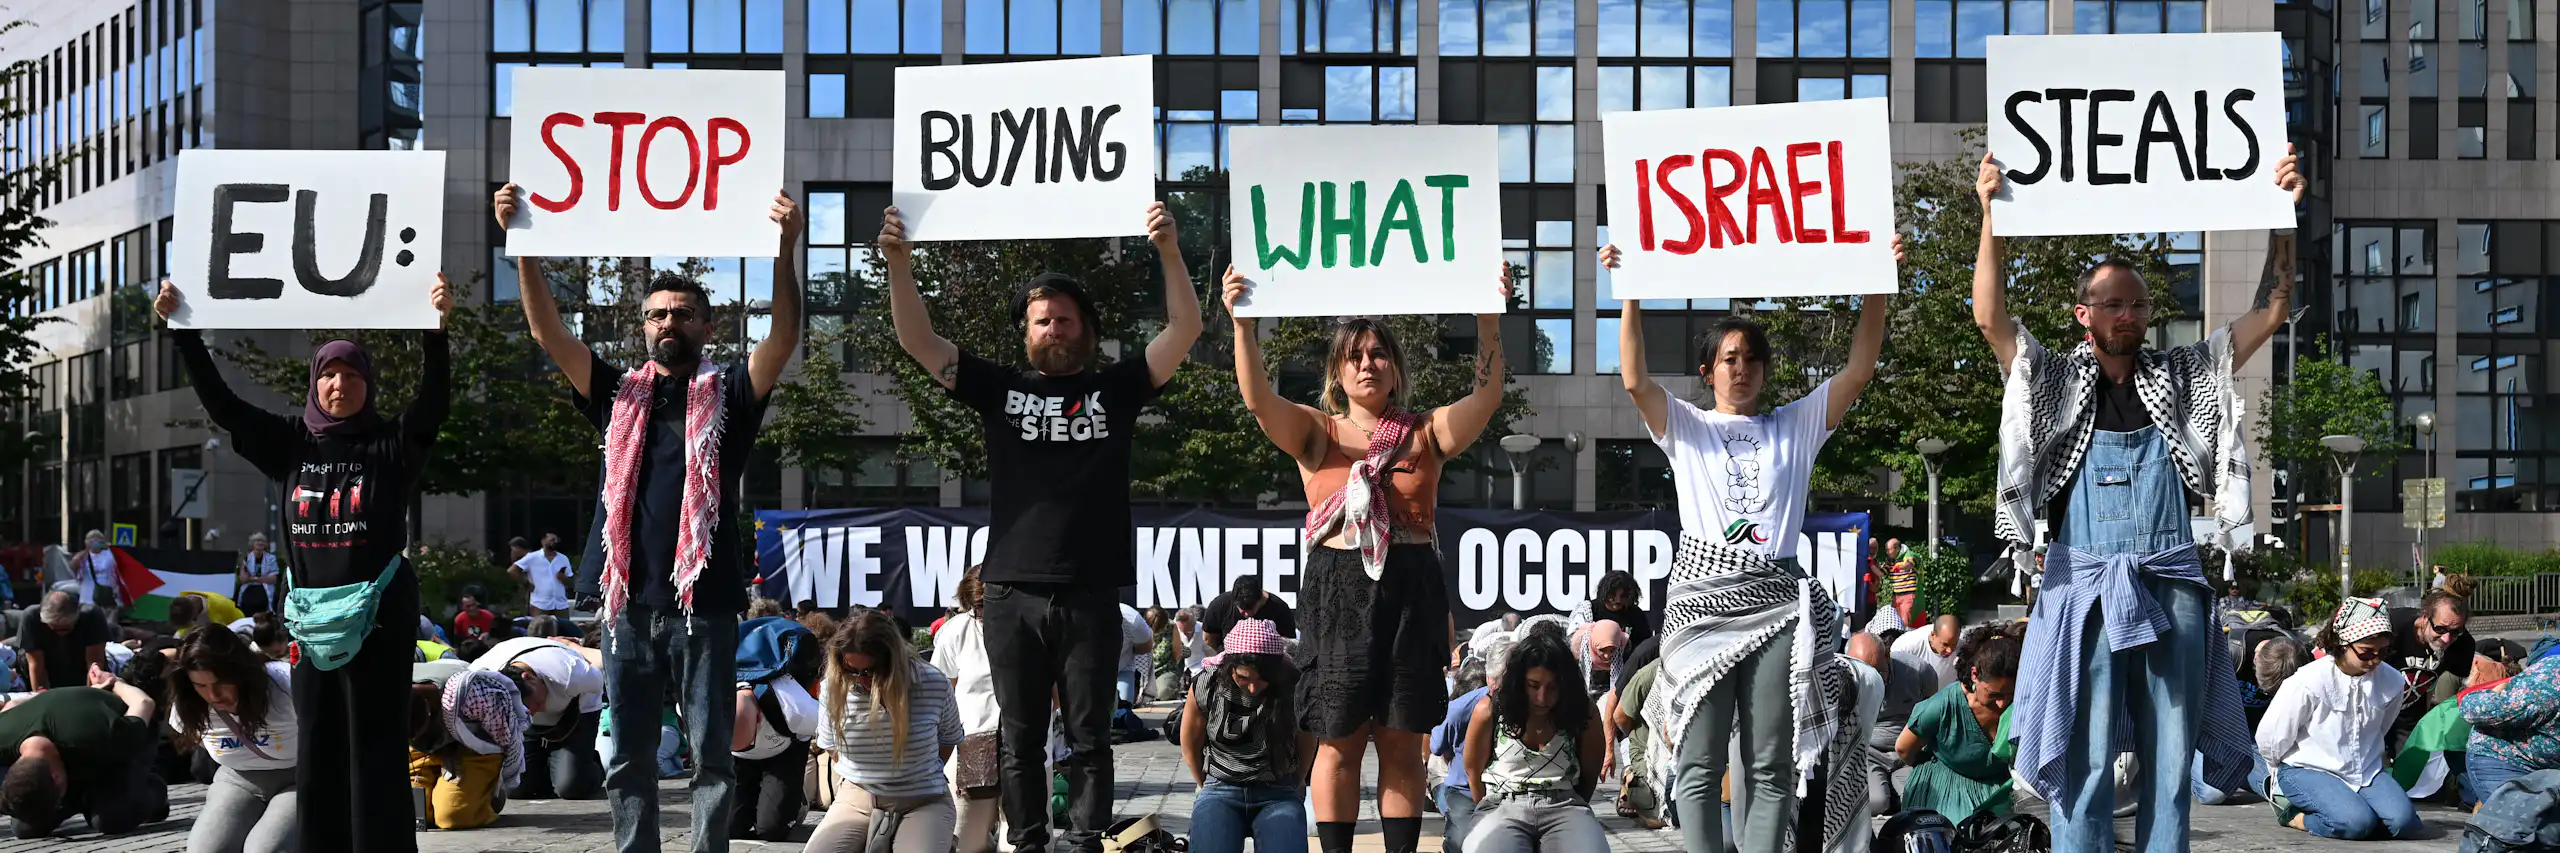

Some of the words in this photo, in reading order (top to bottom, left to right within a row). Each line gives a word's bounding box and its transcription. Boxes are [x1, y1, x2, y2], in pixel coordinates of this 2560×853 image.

[529, 111, 751, 213] STOP
[920, 104, 1127, 191] BUYING
[2003, 88, 2260, 186] STEALS
[207, 183, 417, 301] EU:
[1250, 174, 1470, 271] WHAT
[1634, 140, 1871, 256] ISRAEL
[301, 462, 332, 474] SMASH
[337, 463, 348, 472] IT
[291, 523, 317, 534] SHUT
[322, 524, 331, 534] IT
[335, 521, 367, 534] DOWN
[782, 526, 884, 608] WE
[1136, 527, 1309, 609] KNEE
[220, 734, 269, 749] AVZ
